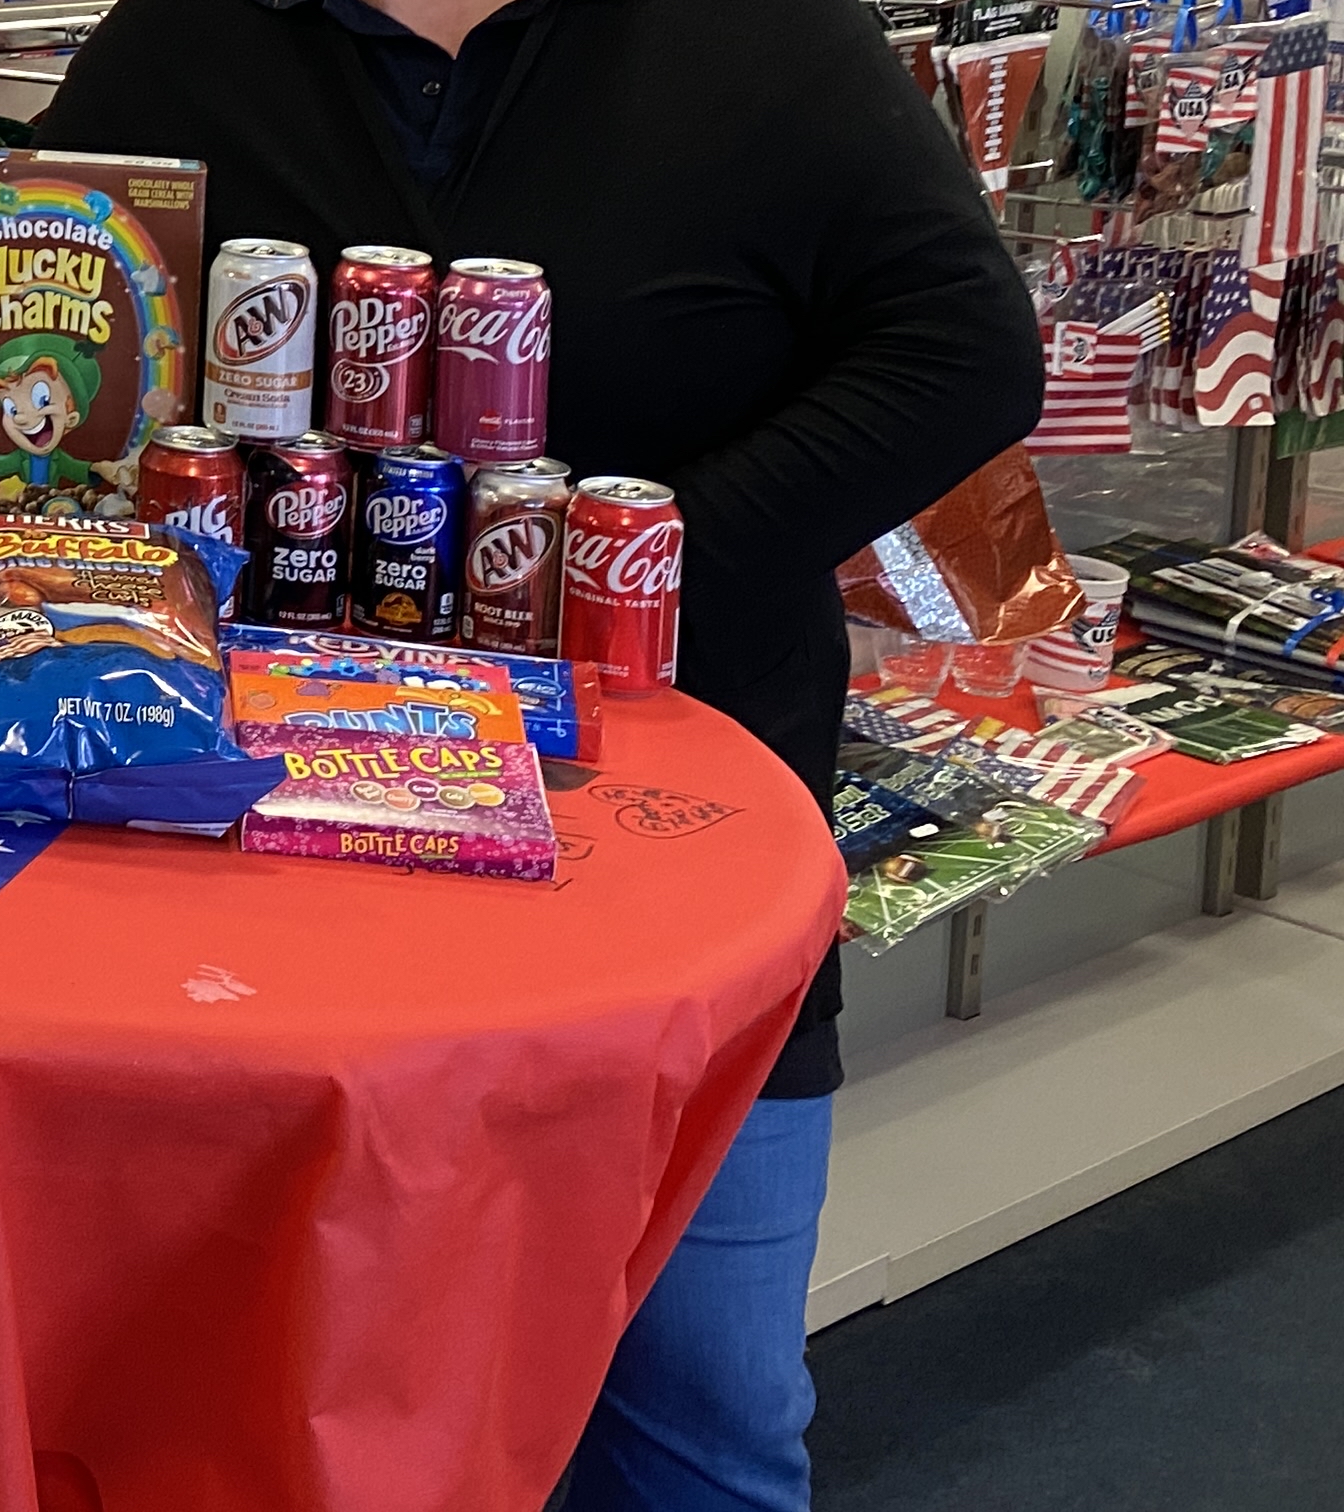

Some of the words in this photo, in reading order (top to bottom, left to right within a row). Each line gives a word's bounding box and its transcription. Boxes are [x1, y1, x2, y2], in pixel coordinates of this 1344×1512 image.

[1178, 100, 1204, 117] USA
[232, 287, 292, 357] A&W
[360, 297, 402, 326] Dr
[334, 300, 426, 357] Pepper
[218, 370, 252, 387] ZERO
[255, 374, 298, 388] SUGAR
[343, 370, 367, 393] 23
[300, 487, 326, 508] Dr
[396, 495, 423, 514] Dr
[276, 493, 344, 530] Pepper
[374, 499, 441, 536] Pepper
[273, 547, 337, 567] zero
[480, 517, 536, 588] A&W
[272, 569, 336, 583] SUGAR
[375, 559, 427, 578] zero
[374, 574, 426, 590] SUGAR
[569, 586, 621, 607] ORIGINAL
[624, 598, 661, 609] TASTE
[11, 611, 49, 627] MADE
[1092, 627, 1115, 643] US
[58, 697, 82, 717] NET
[84, 698, 102, 719] WT
[104, 703, 111, 721] 7
[136, 706, 175, 728] (198g)
[284, 747, 410, 781] BOTTLE
[410, 746, 503, 775] CAPS
[341, 832, 407, 857] BOTTLE
[410, 835, 459, 858] CAPS
